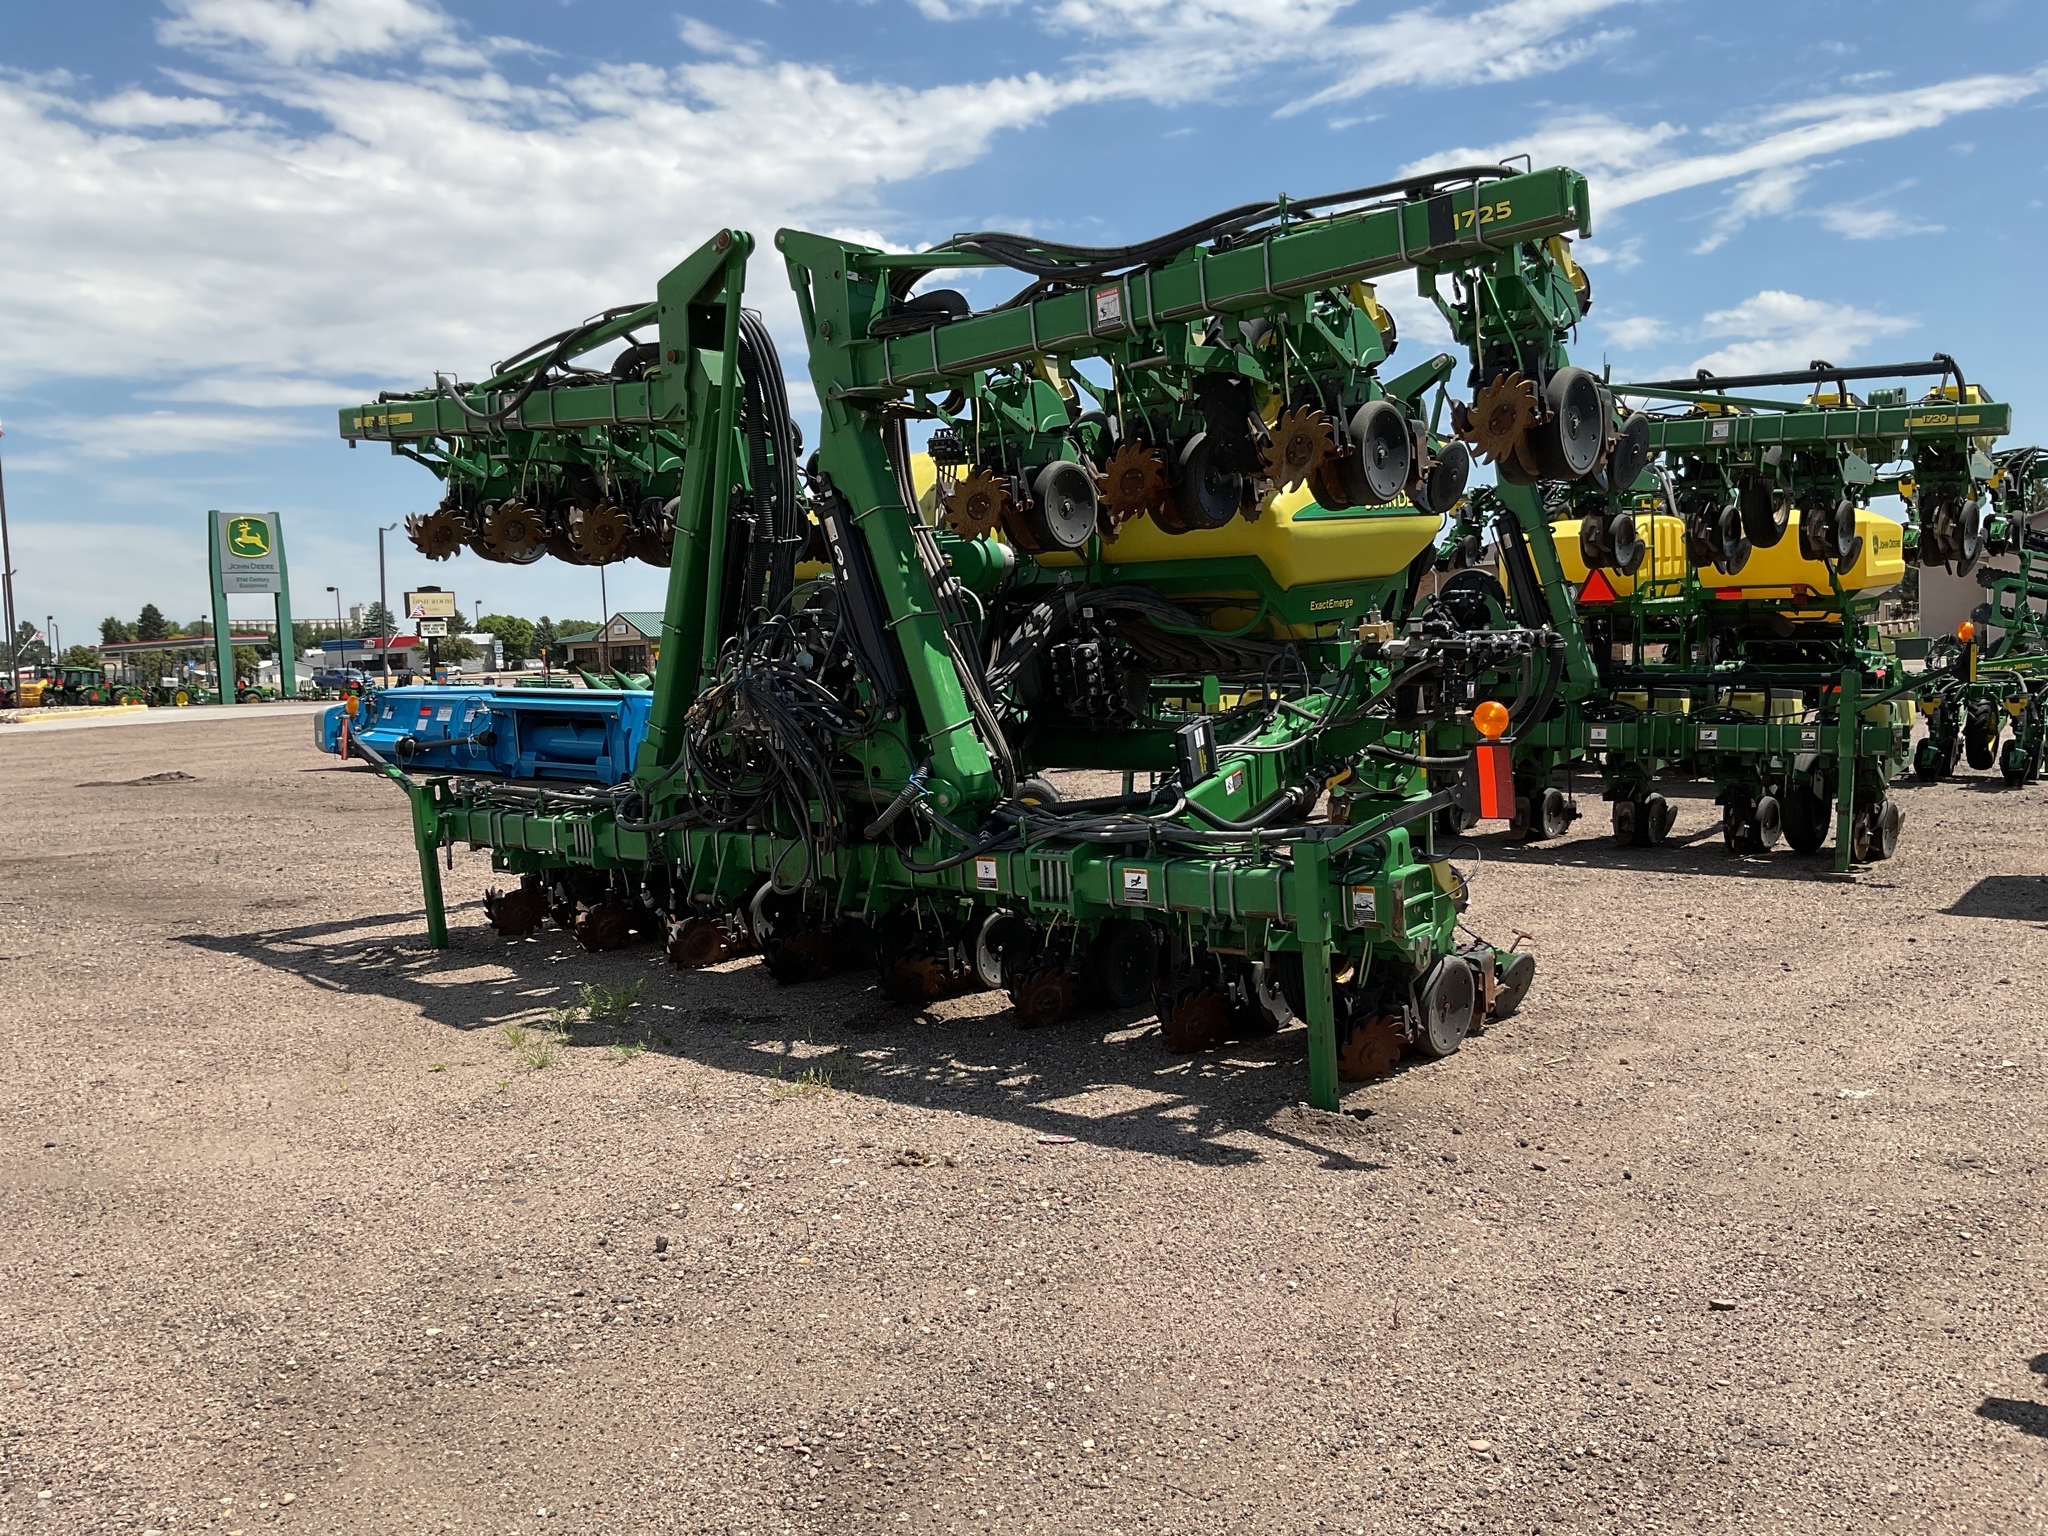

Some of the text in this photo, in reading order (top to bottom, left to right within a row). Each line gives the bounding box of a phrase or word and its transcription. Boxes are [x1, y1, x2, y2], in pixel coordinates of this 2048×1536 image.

[1453, 200, 1513, 231] 1725
[1100, 288, 1119, 297] DANGER
[382, 416, 400, 426] DERE
[1922, 414, 1948, 424] 1720
[1310, 599, 1354, 611] ExactEmerge
